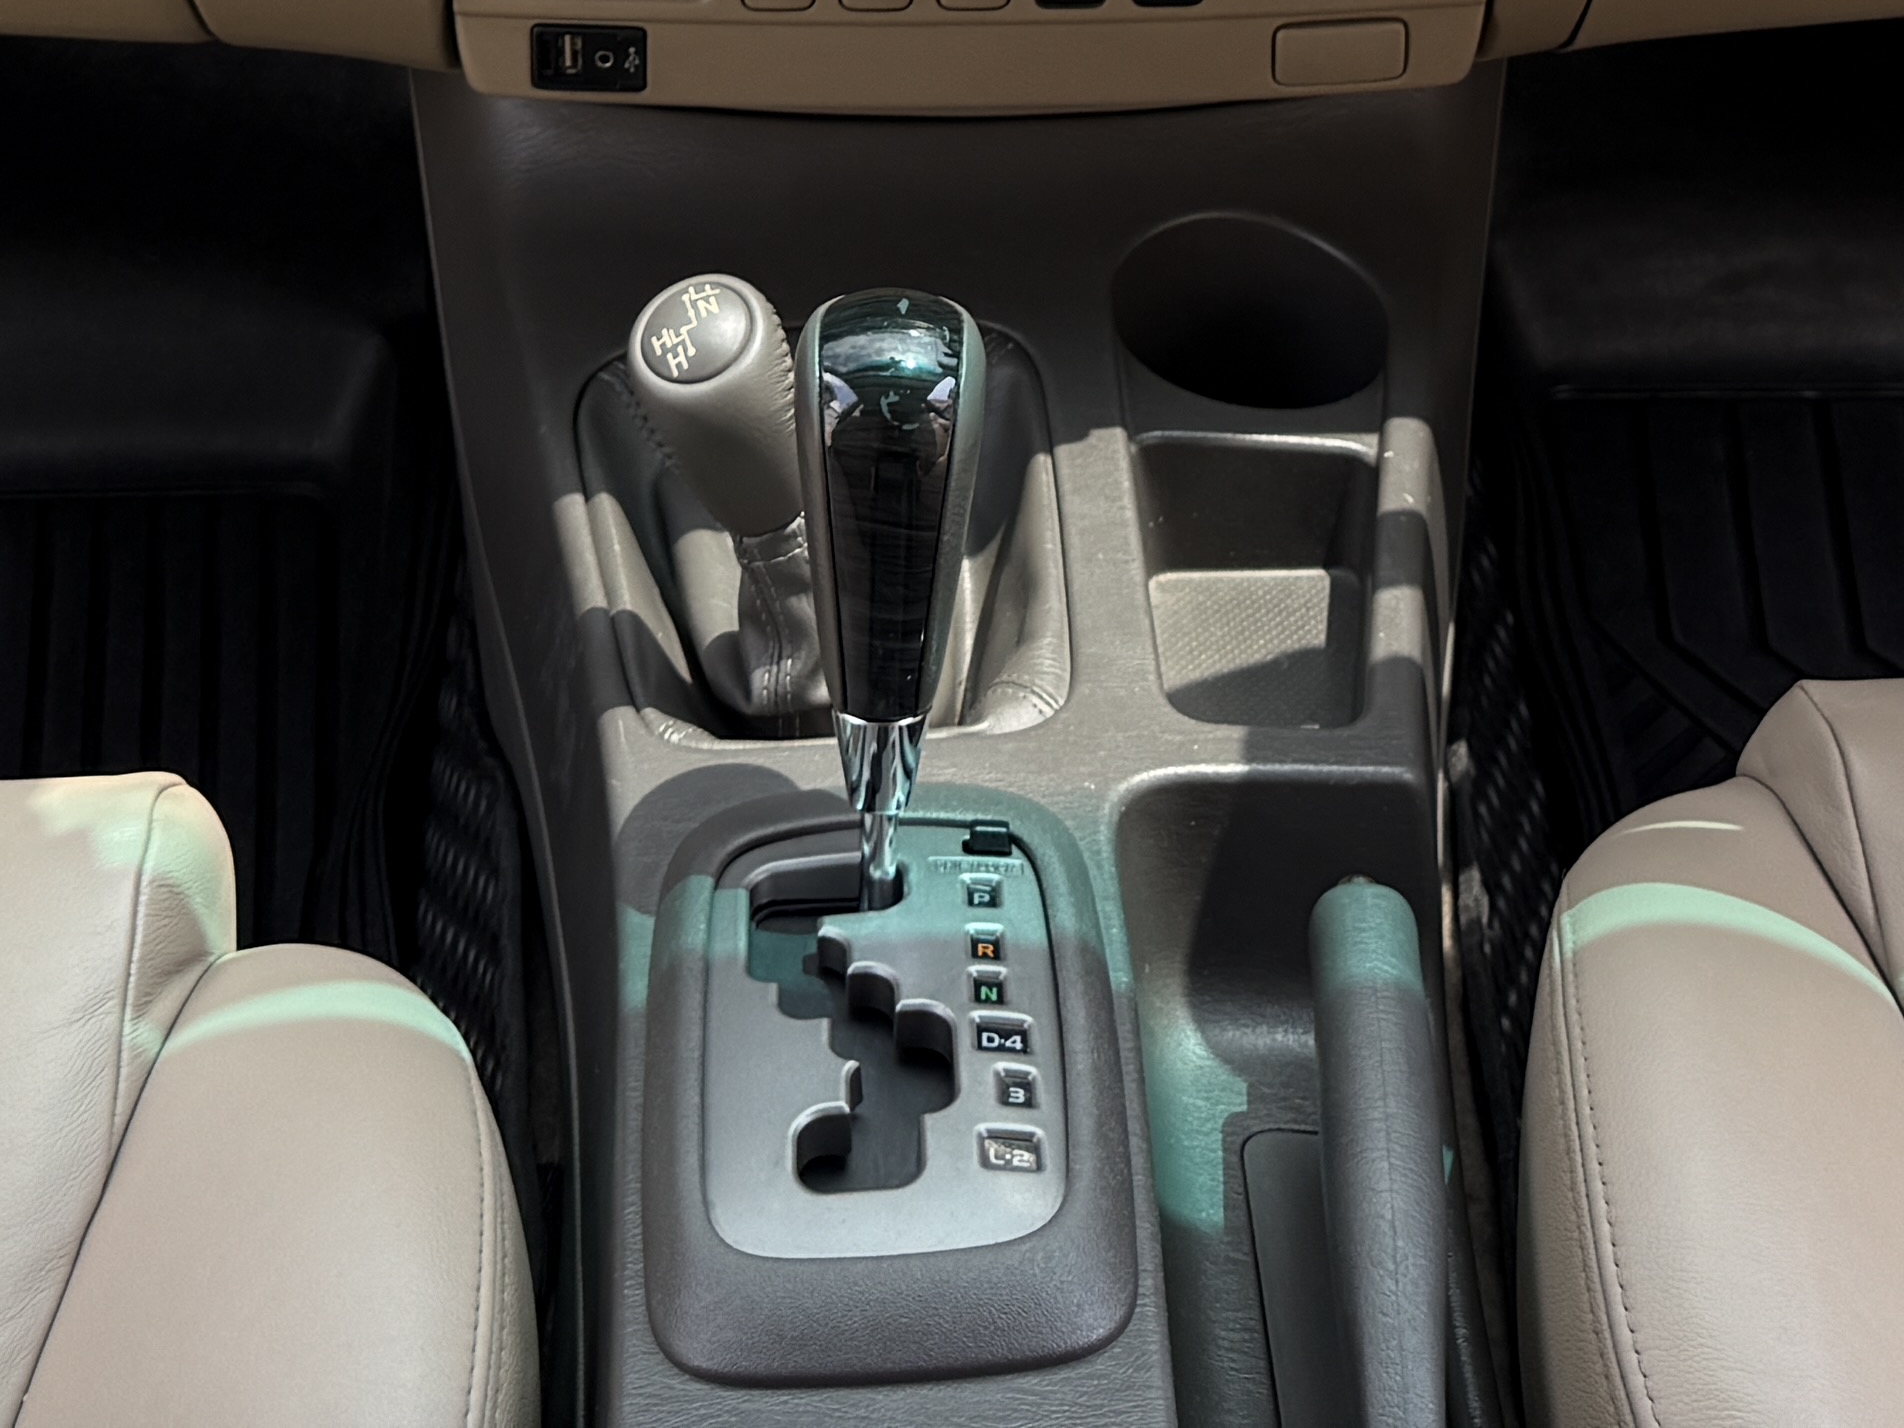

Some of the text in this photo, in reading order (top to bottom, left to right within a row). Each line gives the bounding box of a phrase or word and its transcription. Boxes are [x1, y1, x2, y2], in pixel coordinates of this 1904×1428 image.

[697, 295, 720, 318] N
[666, 345, 689, 379] H
[973, 892, 991, 905] P
[977, 943, 995, 958] R
[980, 985, 998, 1002] N
[1008, 1087, 1026, 1104] 3
